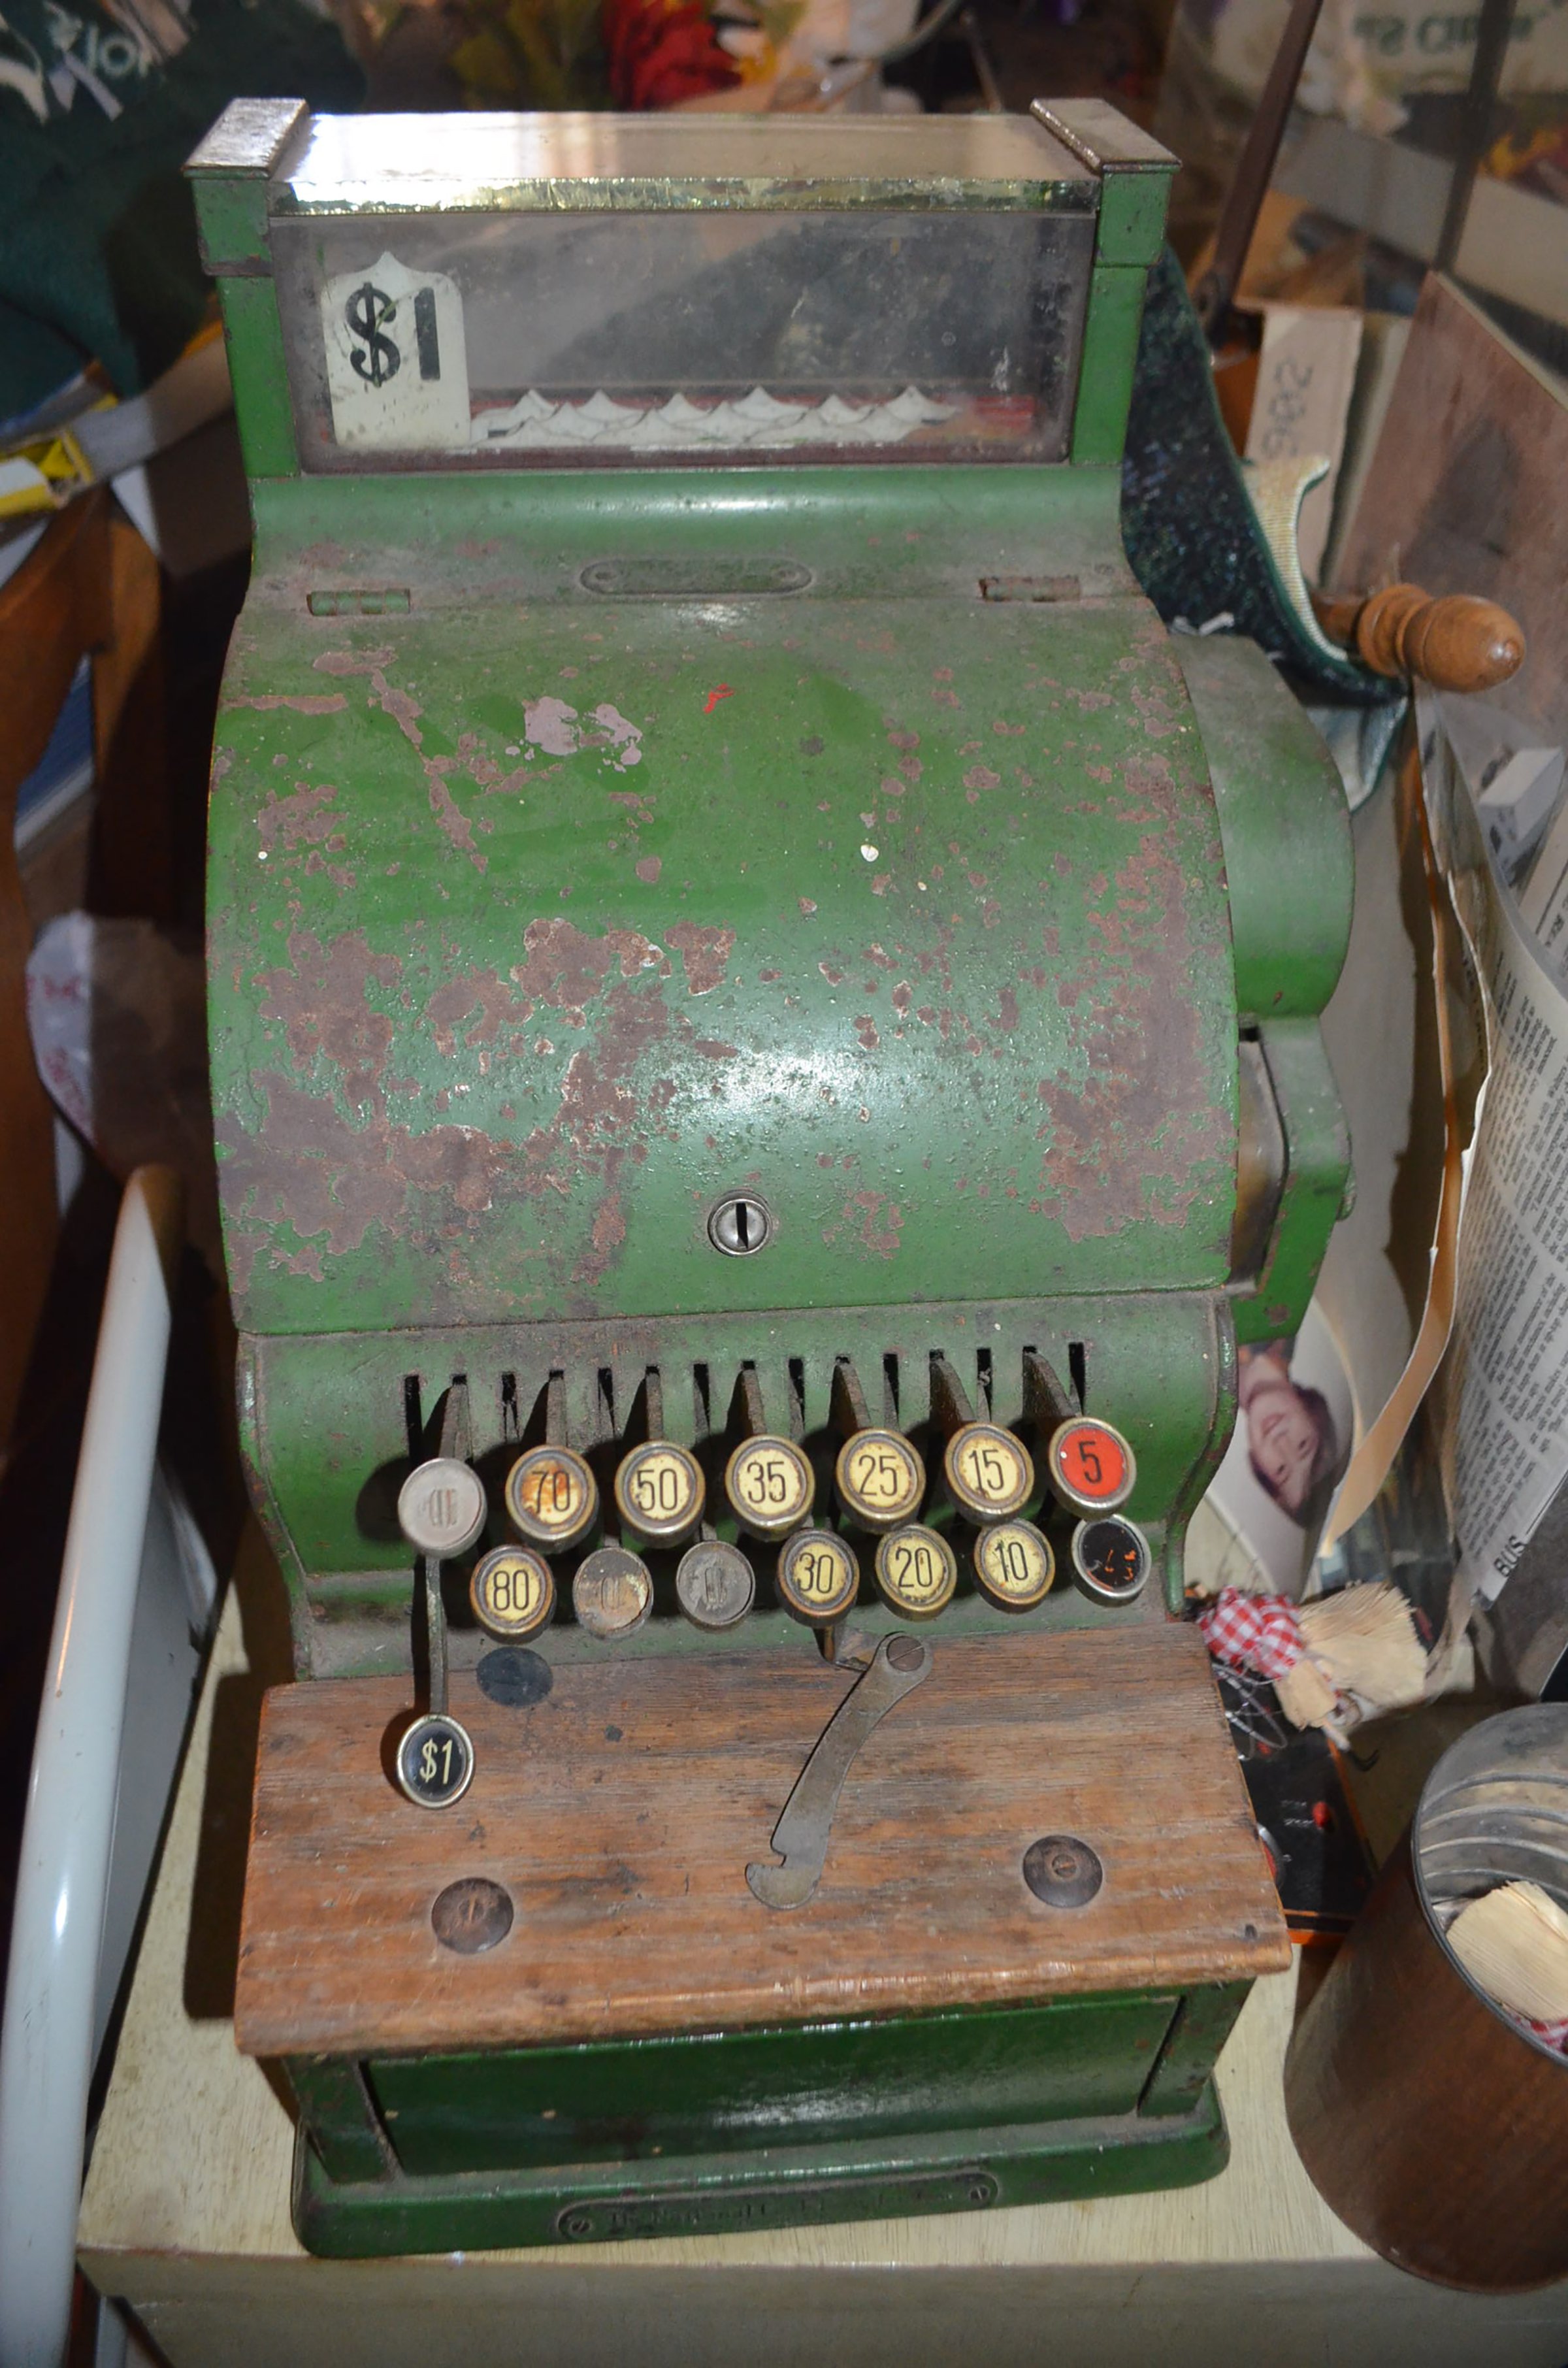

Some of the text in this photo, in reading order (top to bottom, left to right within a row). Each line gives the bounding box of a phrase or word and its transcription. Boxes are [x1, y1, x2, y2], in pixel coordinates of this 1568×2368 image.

[344, 281, 442, 388] $1
[746, 1460, 787, 1504] 35
[857, 1454, 898, 1497] 25
[968, 1448, 1005, 1491] 15
[1078, 1440, 1103, 1485] 5
[530, 1469, 571, 1515] 70
[636, 1468, 678, 1511] 50
[798, 1552, 834, 1594] 30
[894, 1547, 933, 1588] 20
[994, 1541, 1028, 1582] 10
[1493, 1534, 1527, 1578] BUS
[493, 1569, 530, 1612] 80
[419, 1737, 453, 1786] $1
